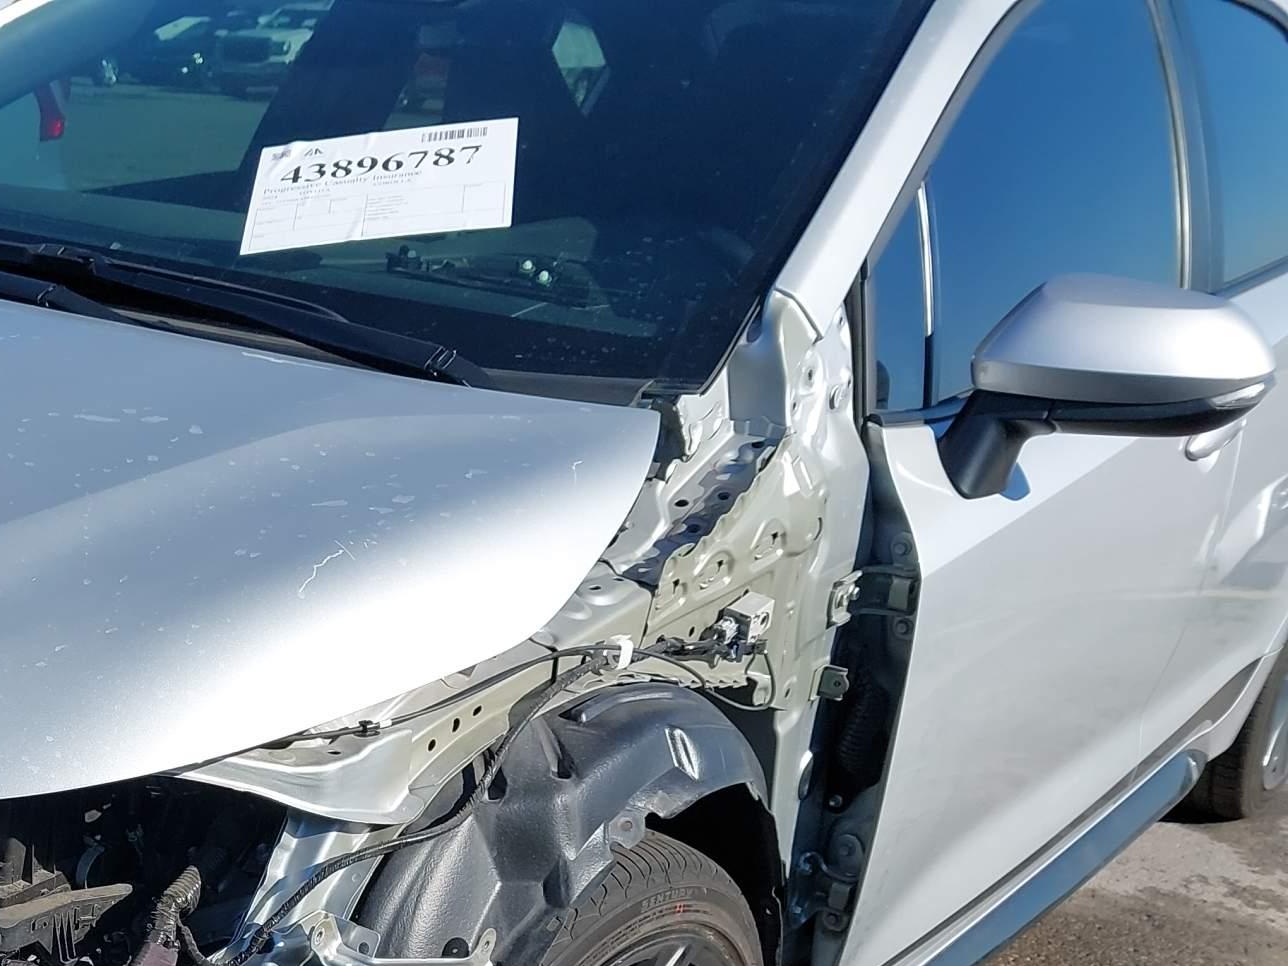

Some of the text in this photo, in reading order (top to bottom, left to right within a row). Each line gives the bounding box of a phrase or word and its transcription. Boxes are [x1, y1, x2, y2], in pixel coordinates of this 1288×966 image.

[280, 144, 482, 184] 43896787
[263, 170, 423, 195] Progressive Casualty Insurance
